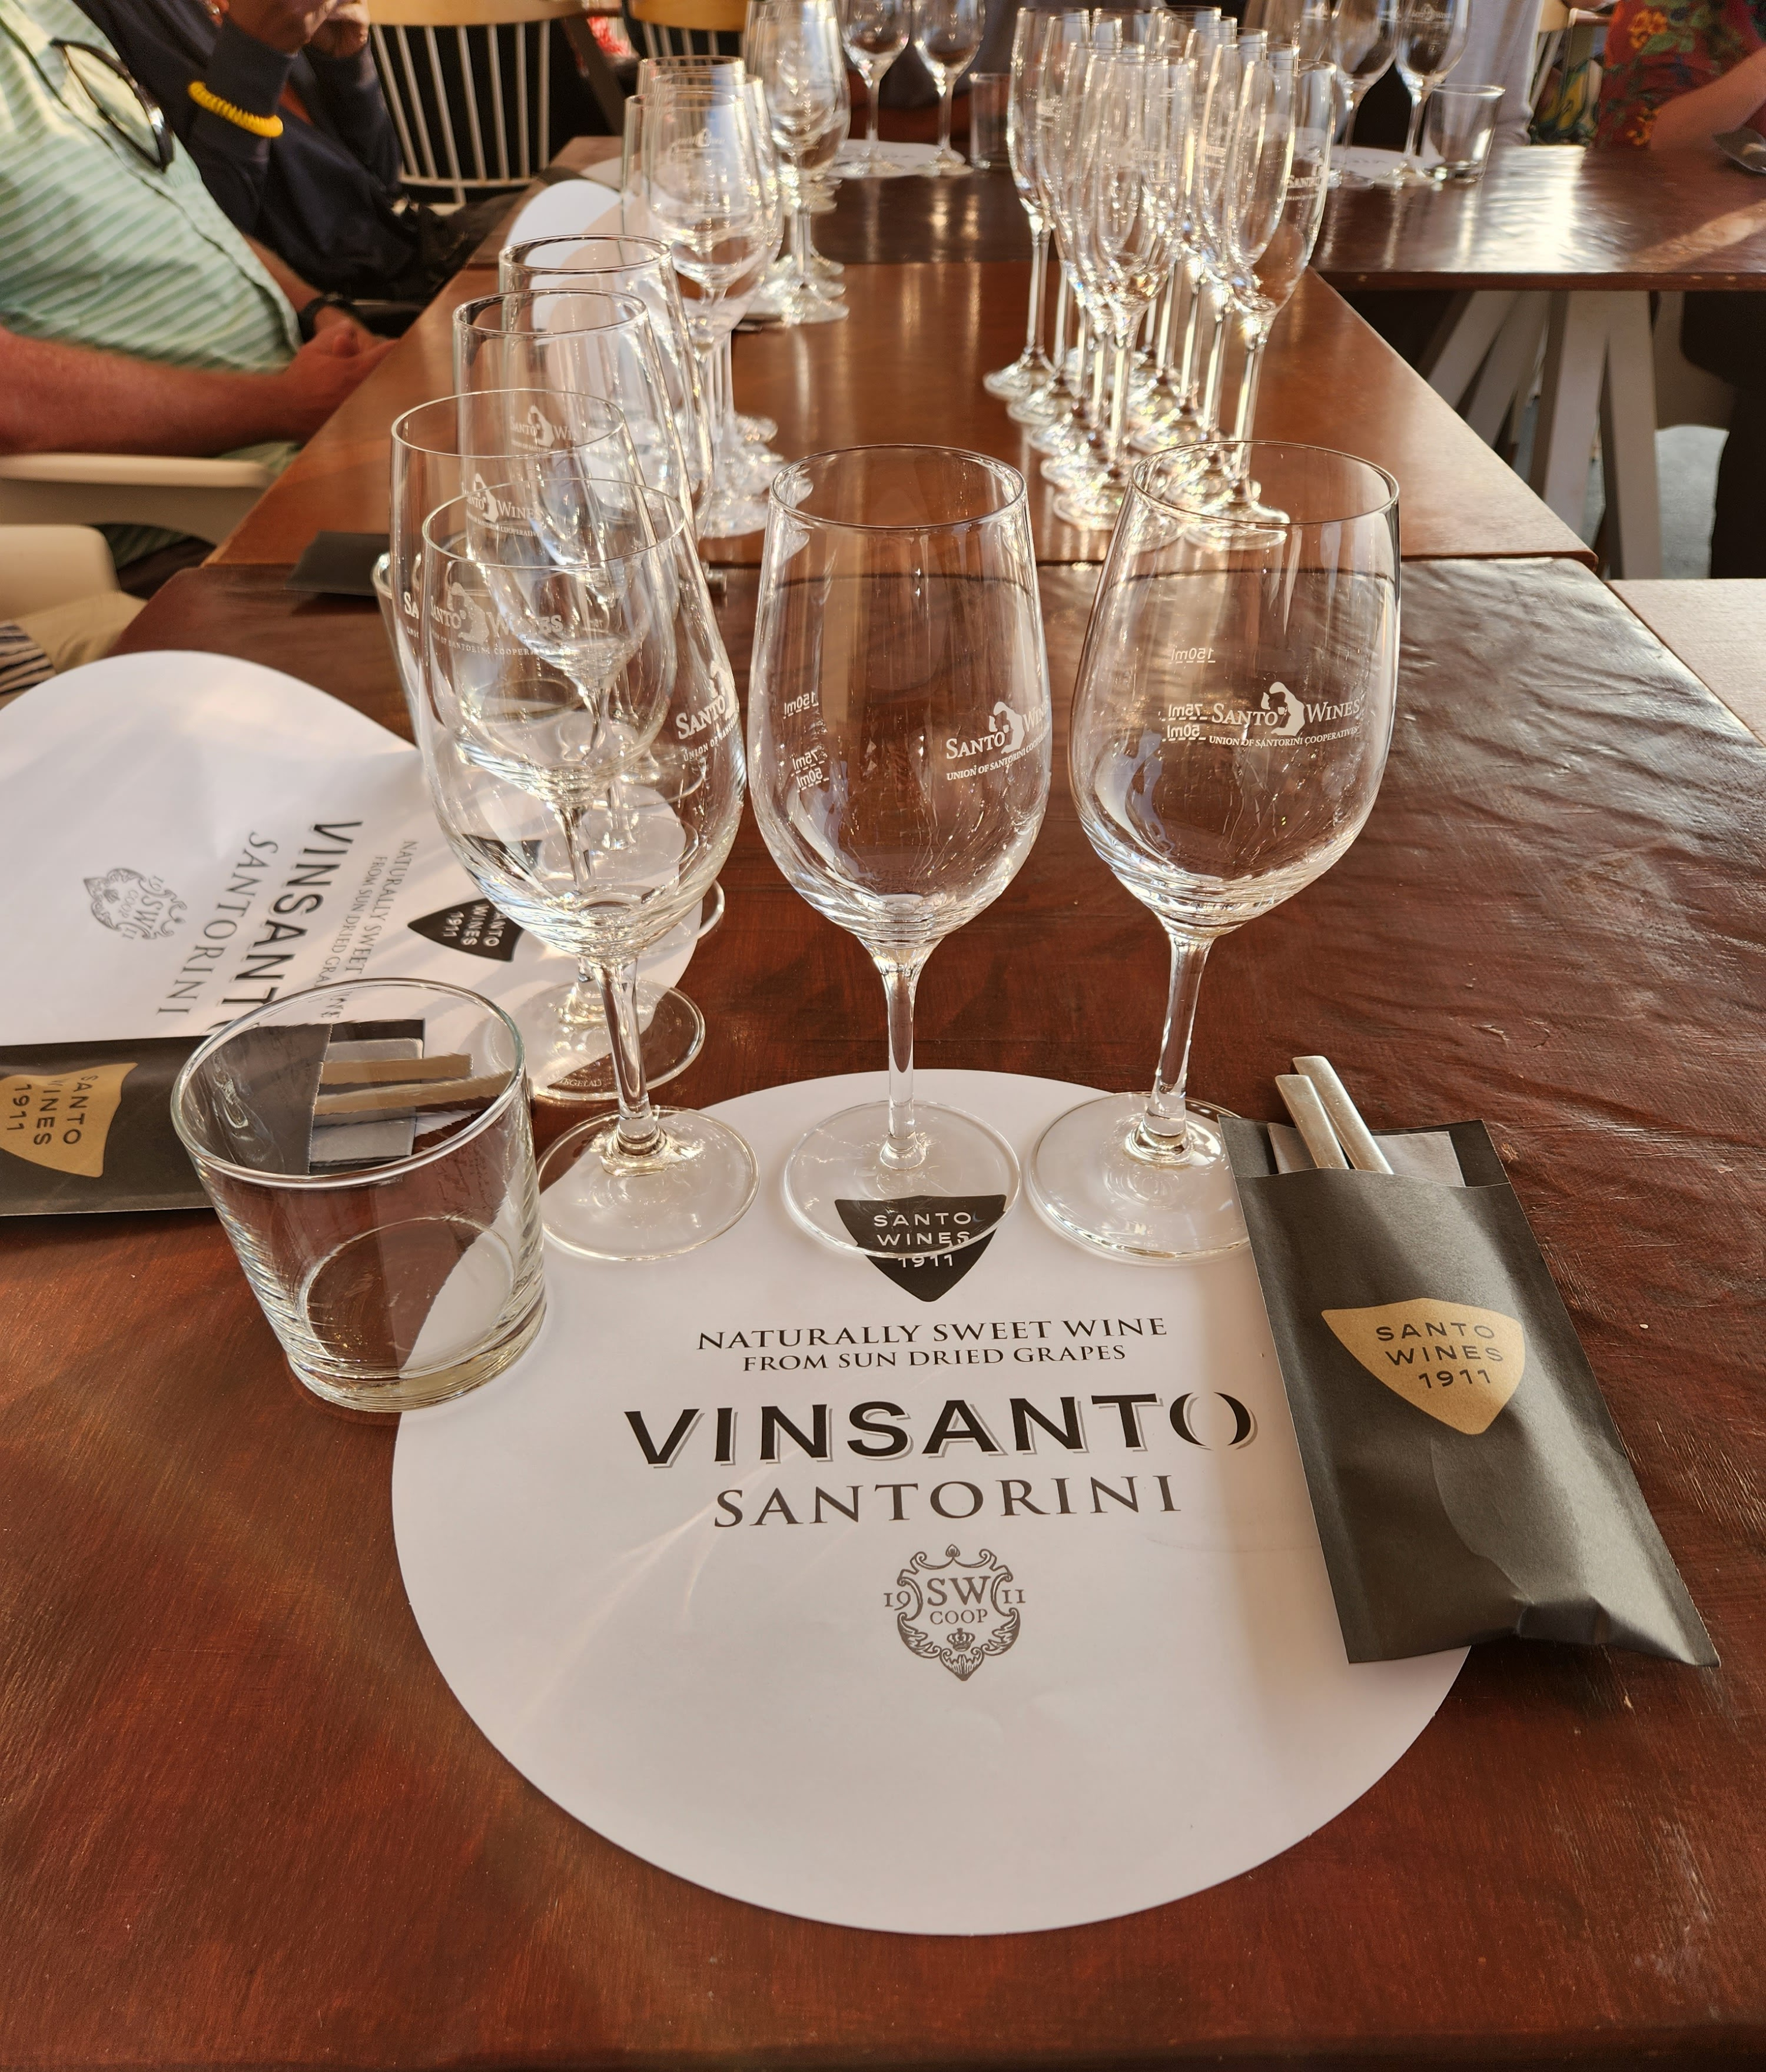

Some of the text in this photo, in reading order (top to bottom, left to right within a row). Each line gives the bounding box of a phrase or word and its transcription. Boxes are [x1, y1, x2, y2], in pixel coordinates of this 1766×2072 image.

[676, 695, 726, 739] SANTO
[1211, 699, 1361, 726] SANTO WINES
[683, 743, 709, 762] UNION
[710, 736, 719, 748] OF
[946, 731, 1005, 759] SANTO
[1209, 735, 1240, 746] UNION
[1256, 737, 1303, 748] SANTORINI
[1304, 726, 1358, 745] COOPERATIVES
[947, 767, 977, 781] UNION
[978, 765, 990, 774] OF
[990, 747, 1026, 771] SANTORINI
[369, 840, 419, 922] NATURALLY
[118, 890, 138, 918] COOP
[133, 895, 164, 929] SW
[156, 830, 279, 1015] SANTORINI
[204, 821, 364, 1031] VINSANT
[314, 856, 388, 987] FROM SUN DRIED GRA
[443, 911, 464, 937] 1911
[460, 904, 490, 945] WINES
[483, 910, 509, 947] ANTO
[345, 925, 382, 974] SWEET
[6, 1084, 32, 1130] 1911
[33, 1078, 71, 1145] WINES
[63, 1075, 99, 1144] SANTO
[874, 1211, 971, 1227] SANTO
[877, 1231, 971, 1246] WINES
[898, 1254, 953, 1268] 1911
[696, 1317, 1167, 1350] NATURALLY SWEET WINE
[1376, 1321, 1495, 1342] SANTO
[743, 1344, 1126, 1372] FROM SUN DRIED GRAPES
[1385, 1345, 1504, 1366] WINES
[1418, 1369, 1491, 1389] 1911
[624, 1392, 1258, 1468] VINSANTO
[714, 1475, 1181, 1528] SANTORINI
[927, 1575, 991, 1606] SW
[930, 1608, 988, 1625] COOP
